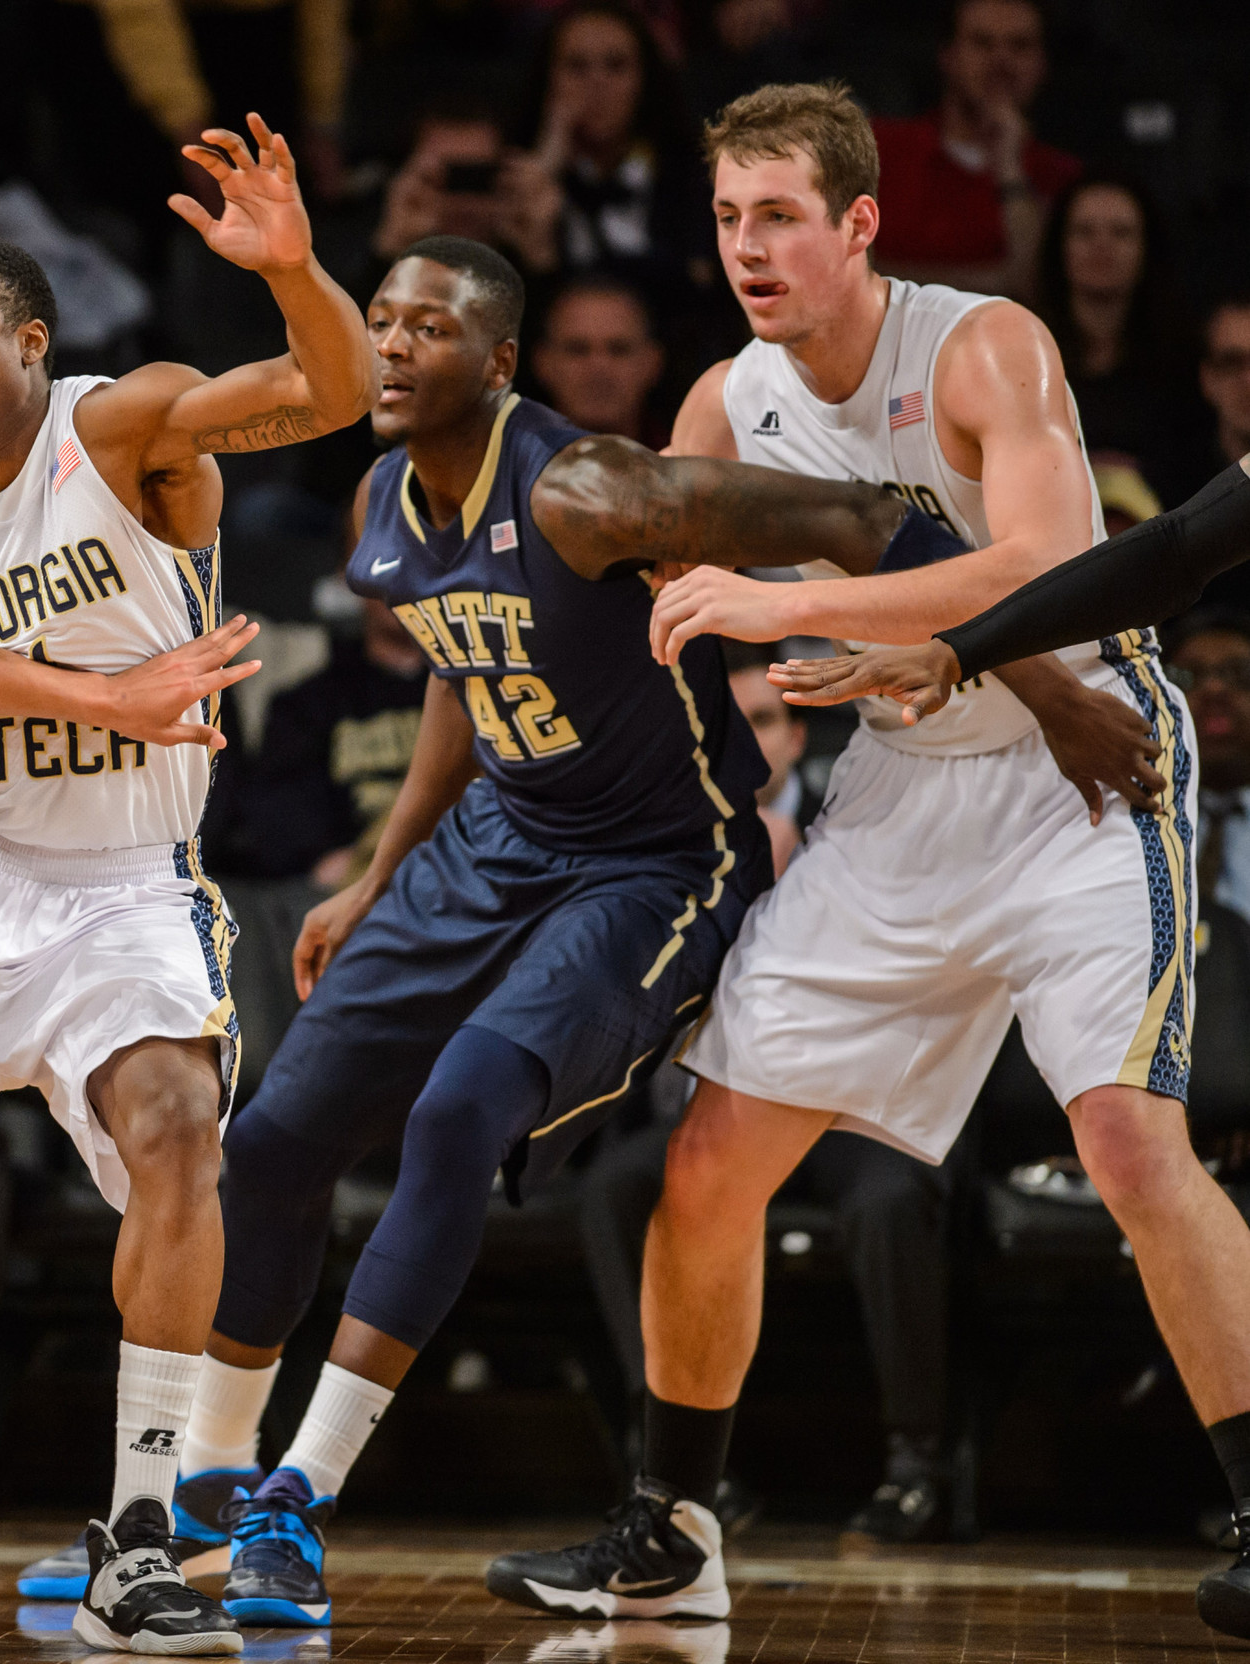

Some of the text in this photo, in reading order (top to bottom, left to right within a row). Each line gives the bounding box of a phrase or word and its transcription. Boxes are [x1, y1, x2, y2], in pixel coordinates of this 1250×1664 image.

[392, 591, 534, 669] PITT
[466, 673, 582, 761] 42
[129, 1442, 179, 1456] RUSSELL
